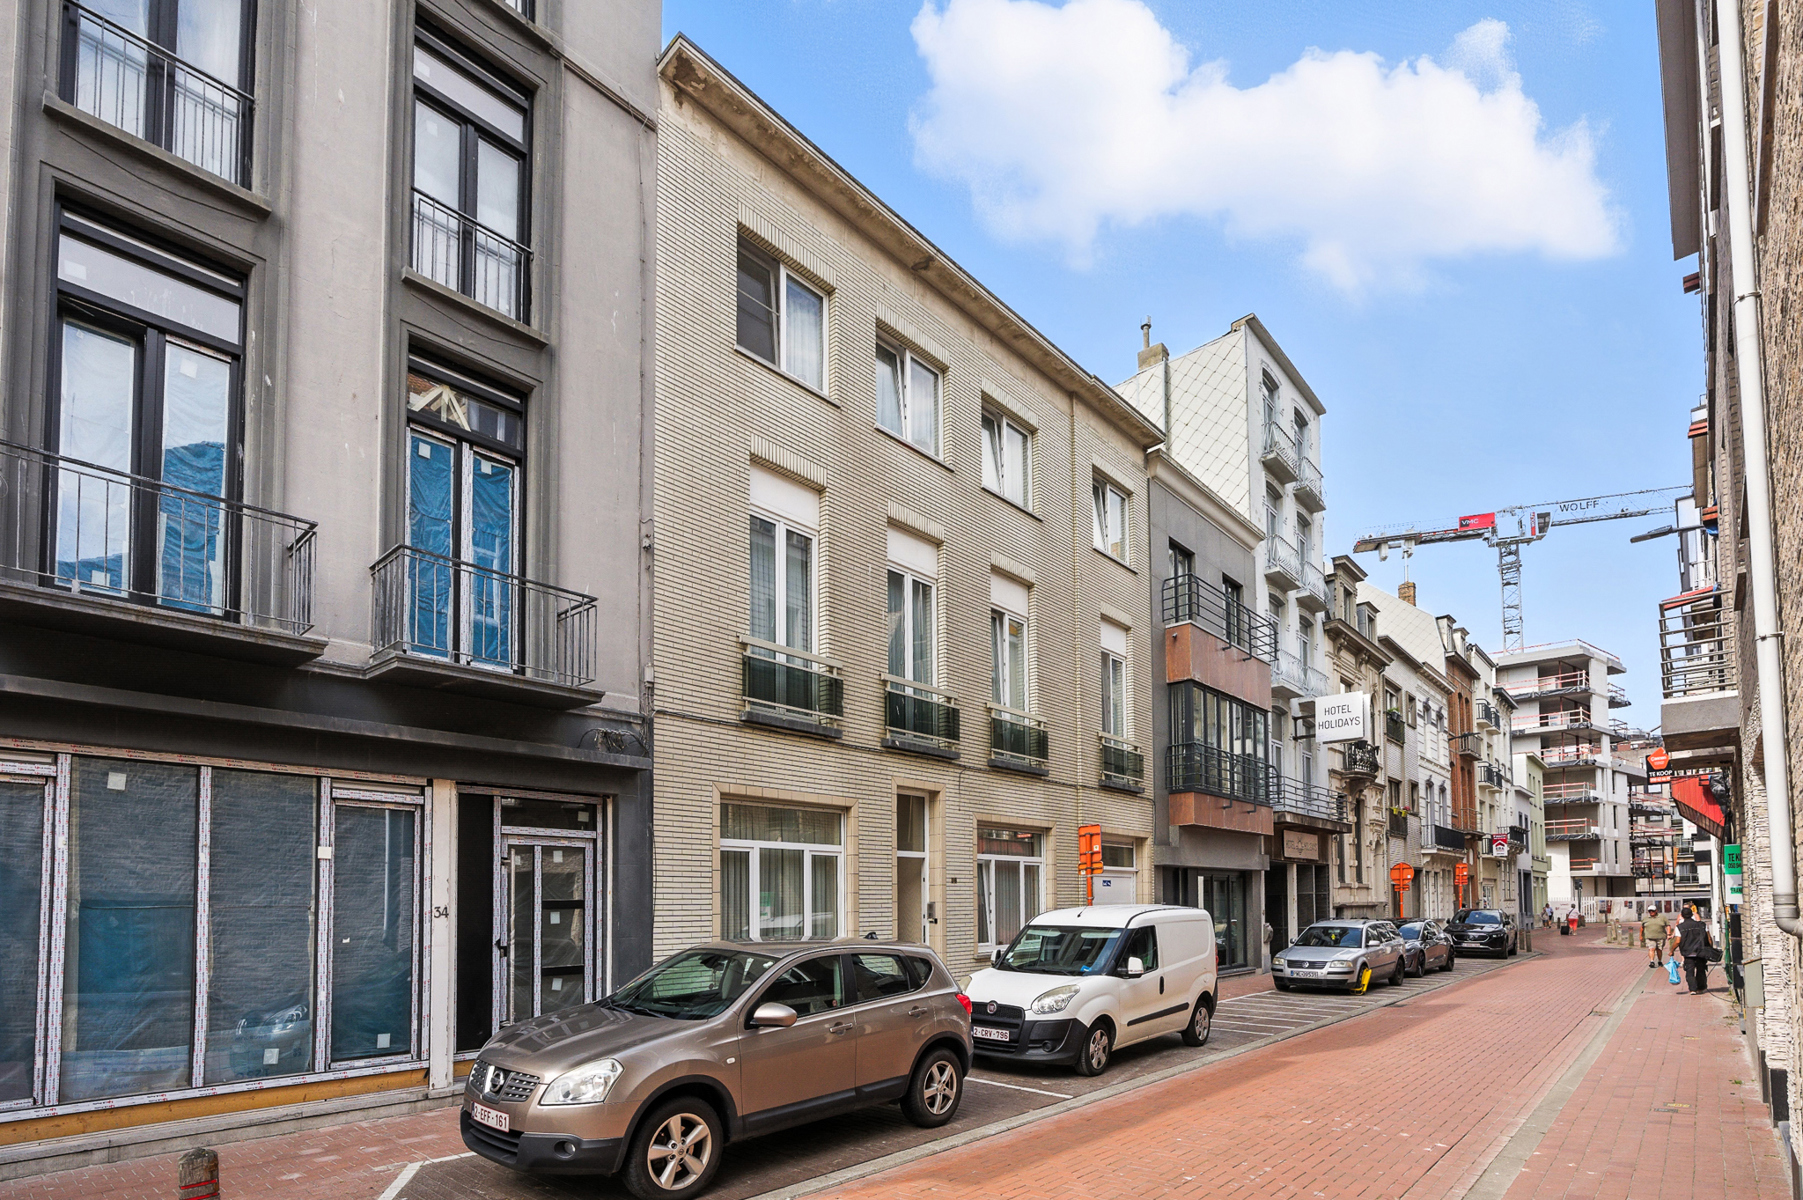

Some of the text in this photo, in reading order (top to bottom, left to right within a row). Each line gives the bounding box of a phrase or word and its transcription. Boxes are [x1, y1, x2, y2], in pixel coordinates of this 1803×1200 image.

[1560, 500, 1599, 512] WOLFF
[1461, 518, 1479, 526] VMC
[1324, 704, 1352, 716] HOTEL
[1318, 716, 1361, 730] HOLIDAYS
[1728, 853, 1735, 862] TE
[434, 906, 449, 919] 34
[974, 1027, 1009, 1040] 2-CRV-796
[474, 1105, 508, 1129] 2-EFF-161
